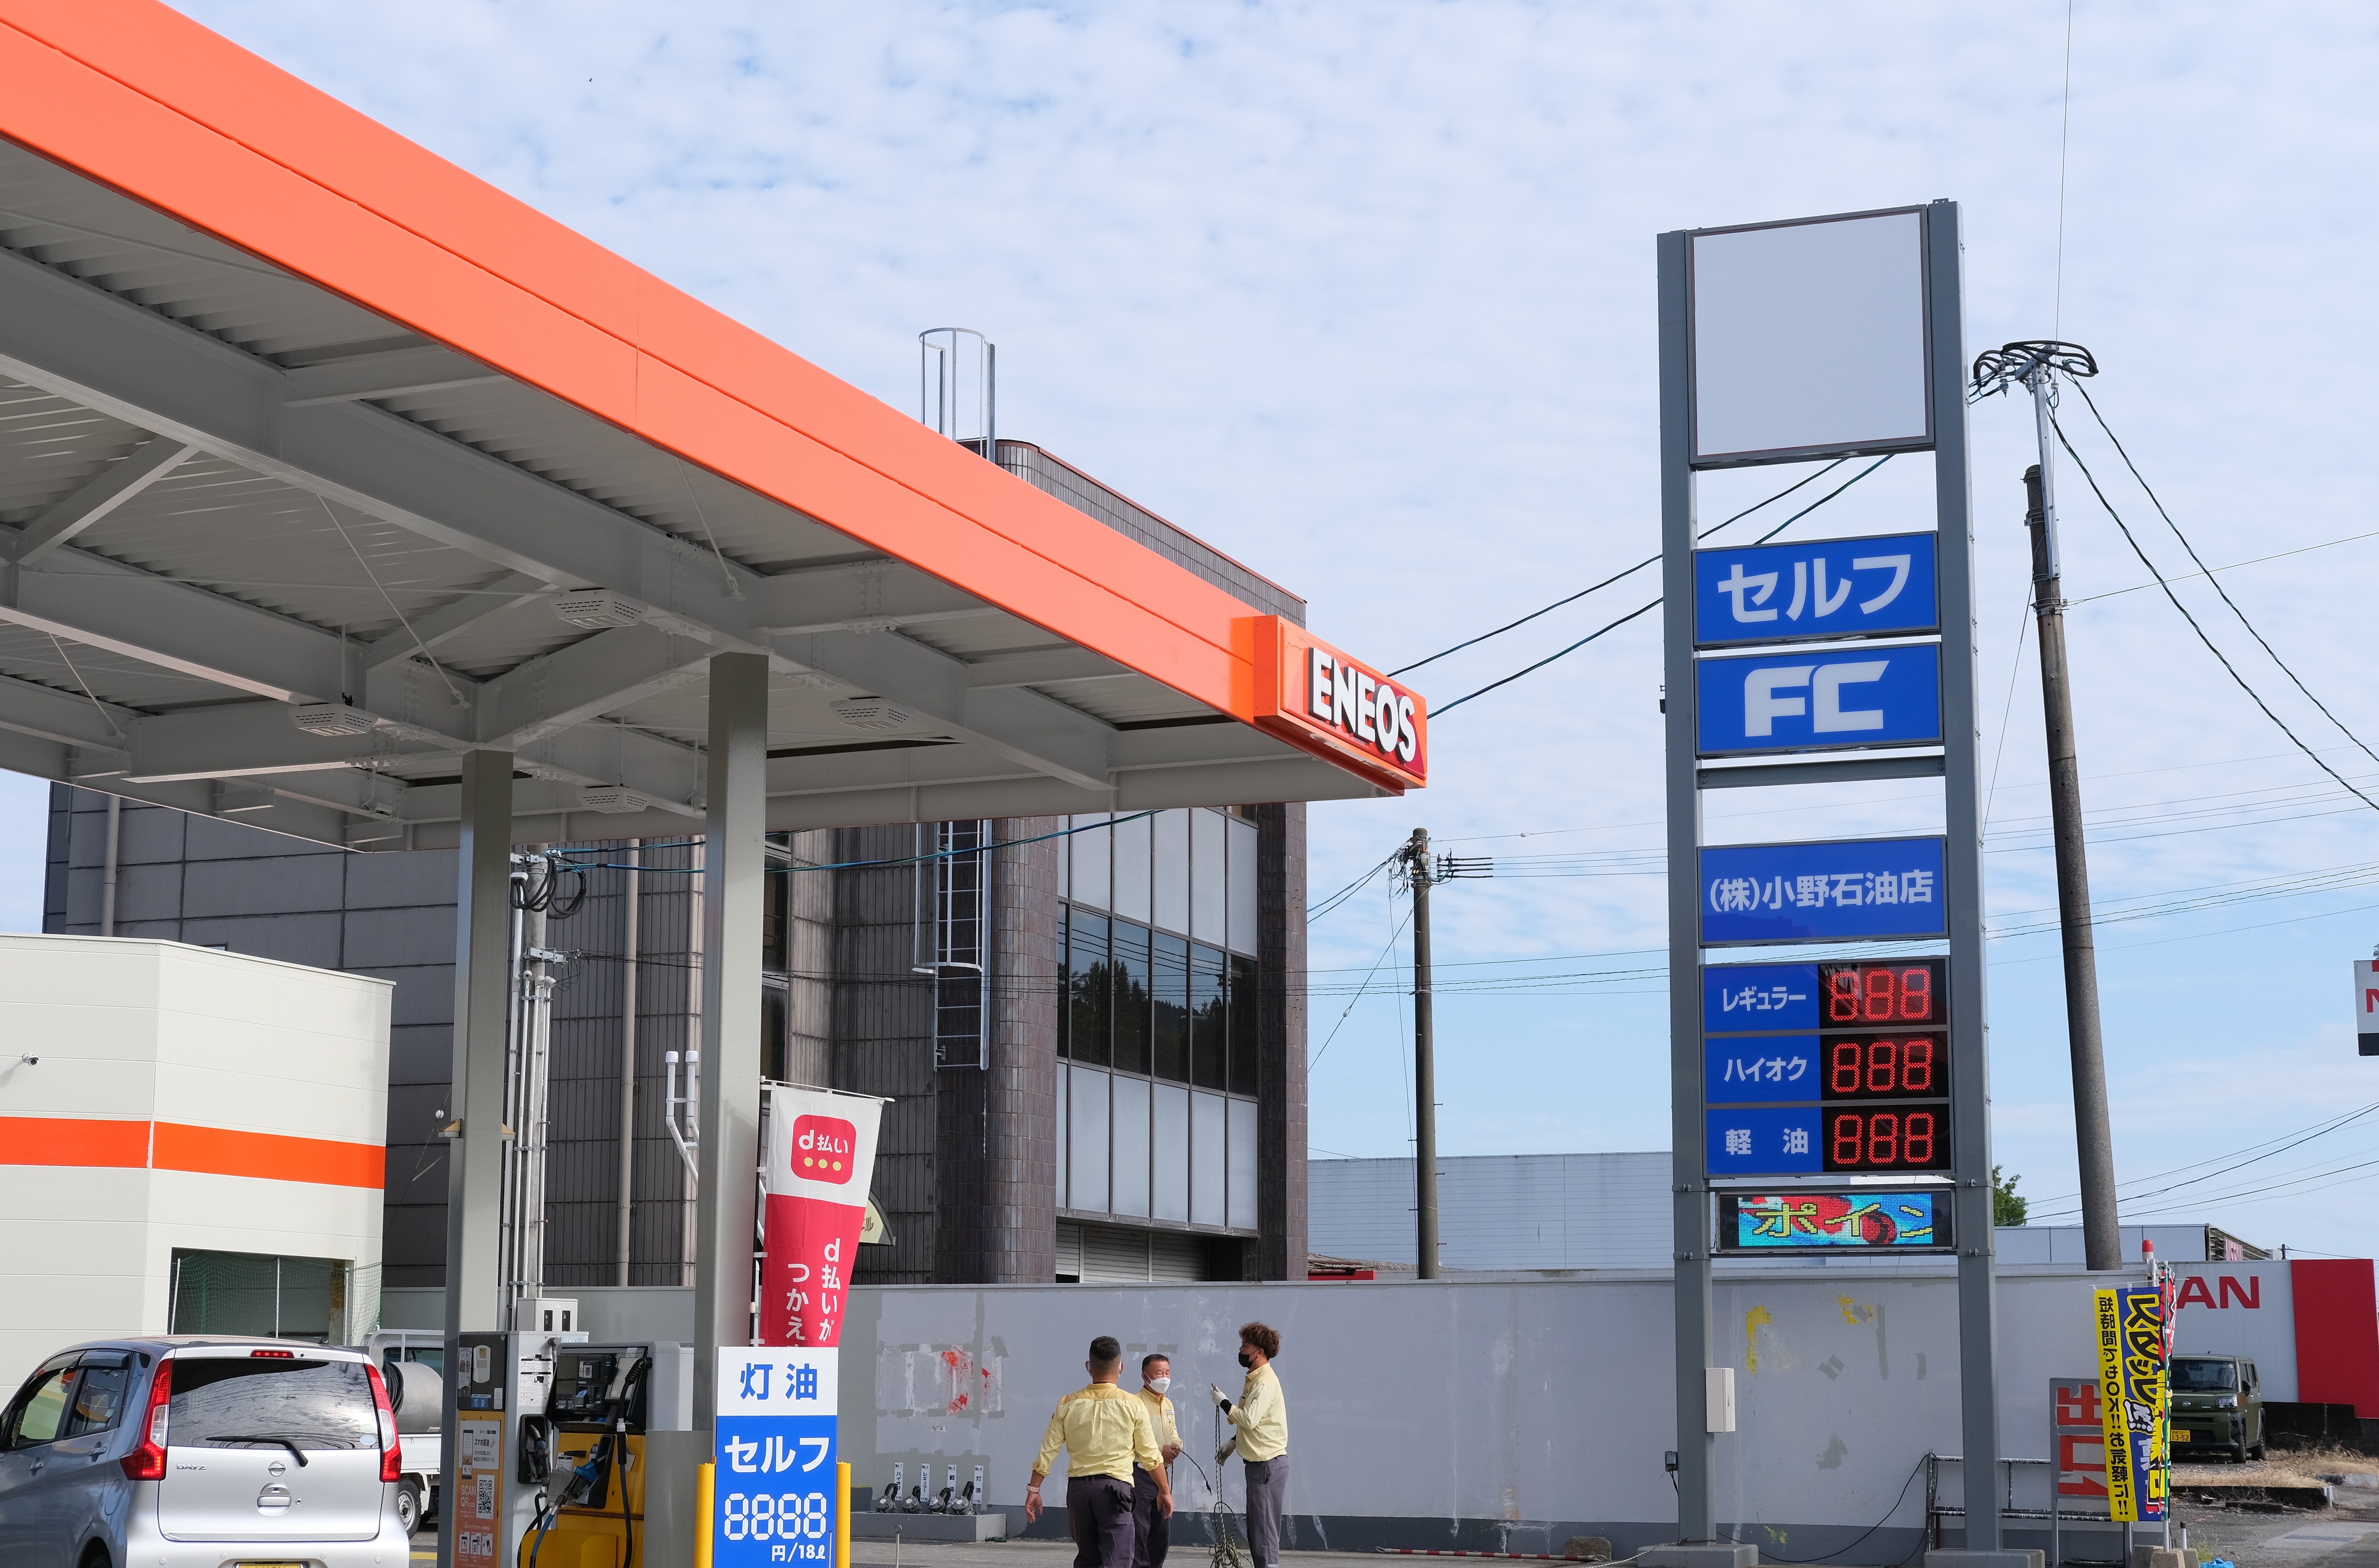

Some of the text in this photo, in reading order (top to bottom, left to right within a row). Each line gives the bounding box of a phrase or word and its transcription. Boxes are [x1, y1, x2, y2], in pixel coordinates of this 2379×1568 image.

[1717, 554, 1911, 623] セルフ
[1309, 647, 1416, 762] ENEOS
[1744, 660, 1890, 737] FC
[1710, 869, 1933, 912] (株)小野石油店
[1723, 986, 1806, 1011] レギュラー
[1830, 969, 1930, 1021] 888
[1724, 1056, 1807, 1082] ハイオク
[1832, 1040, 1932, 1092] 888
[798, 1129, 848, 1154] d払い
[1726, 1128, 1808, 1155] 軽油
[1833, 1113, 1934, 1164] 888
[1753, 1203, 1932, 1237] ポイン
[786, 1263, 810, 1347] つかえ
[818, 1238, 841, 1342] d払いが
[739, 1363, 818, 1400] 灯油
[724, 1436, 830, 1474] セルフ
[461, 1485, 476, 1496] SCAN
[724, 1492, 827, 1540] 8888
